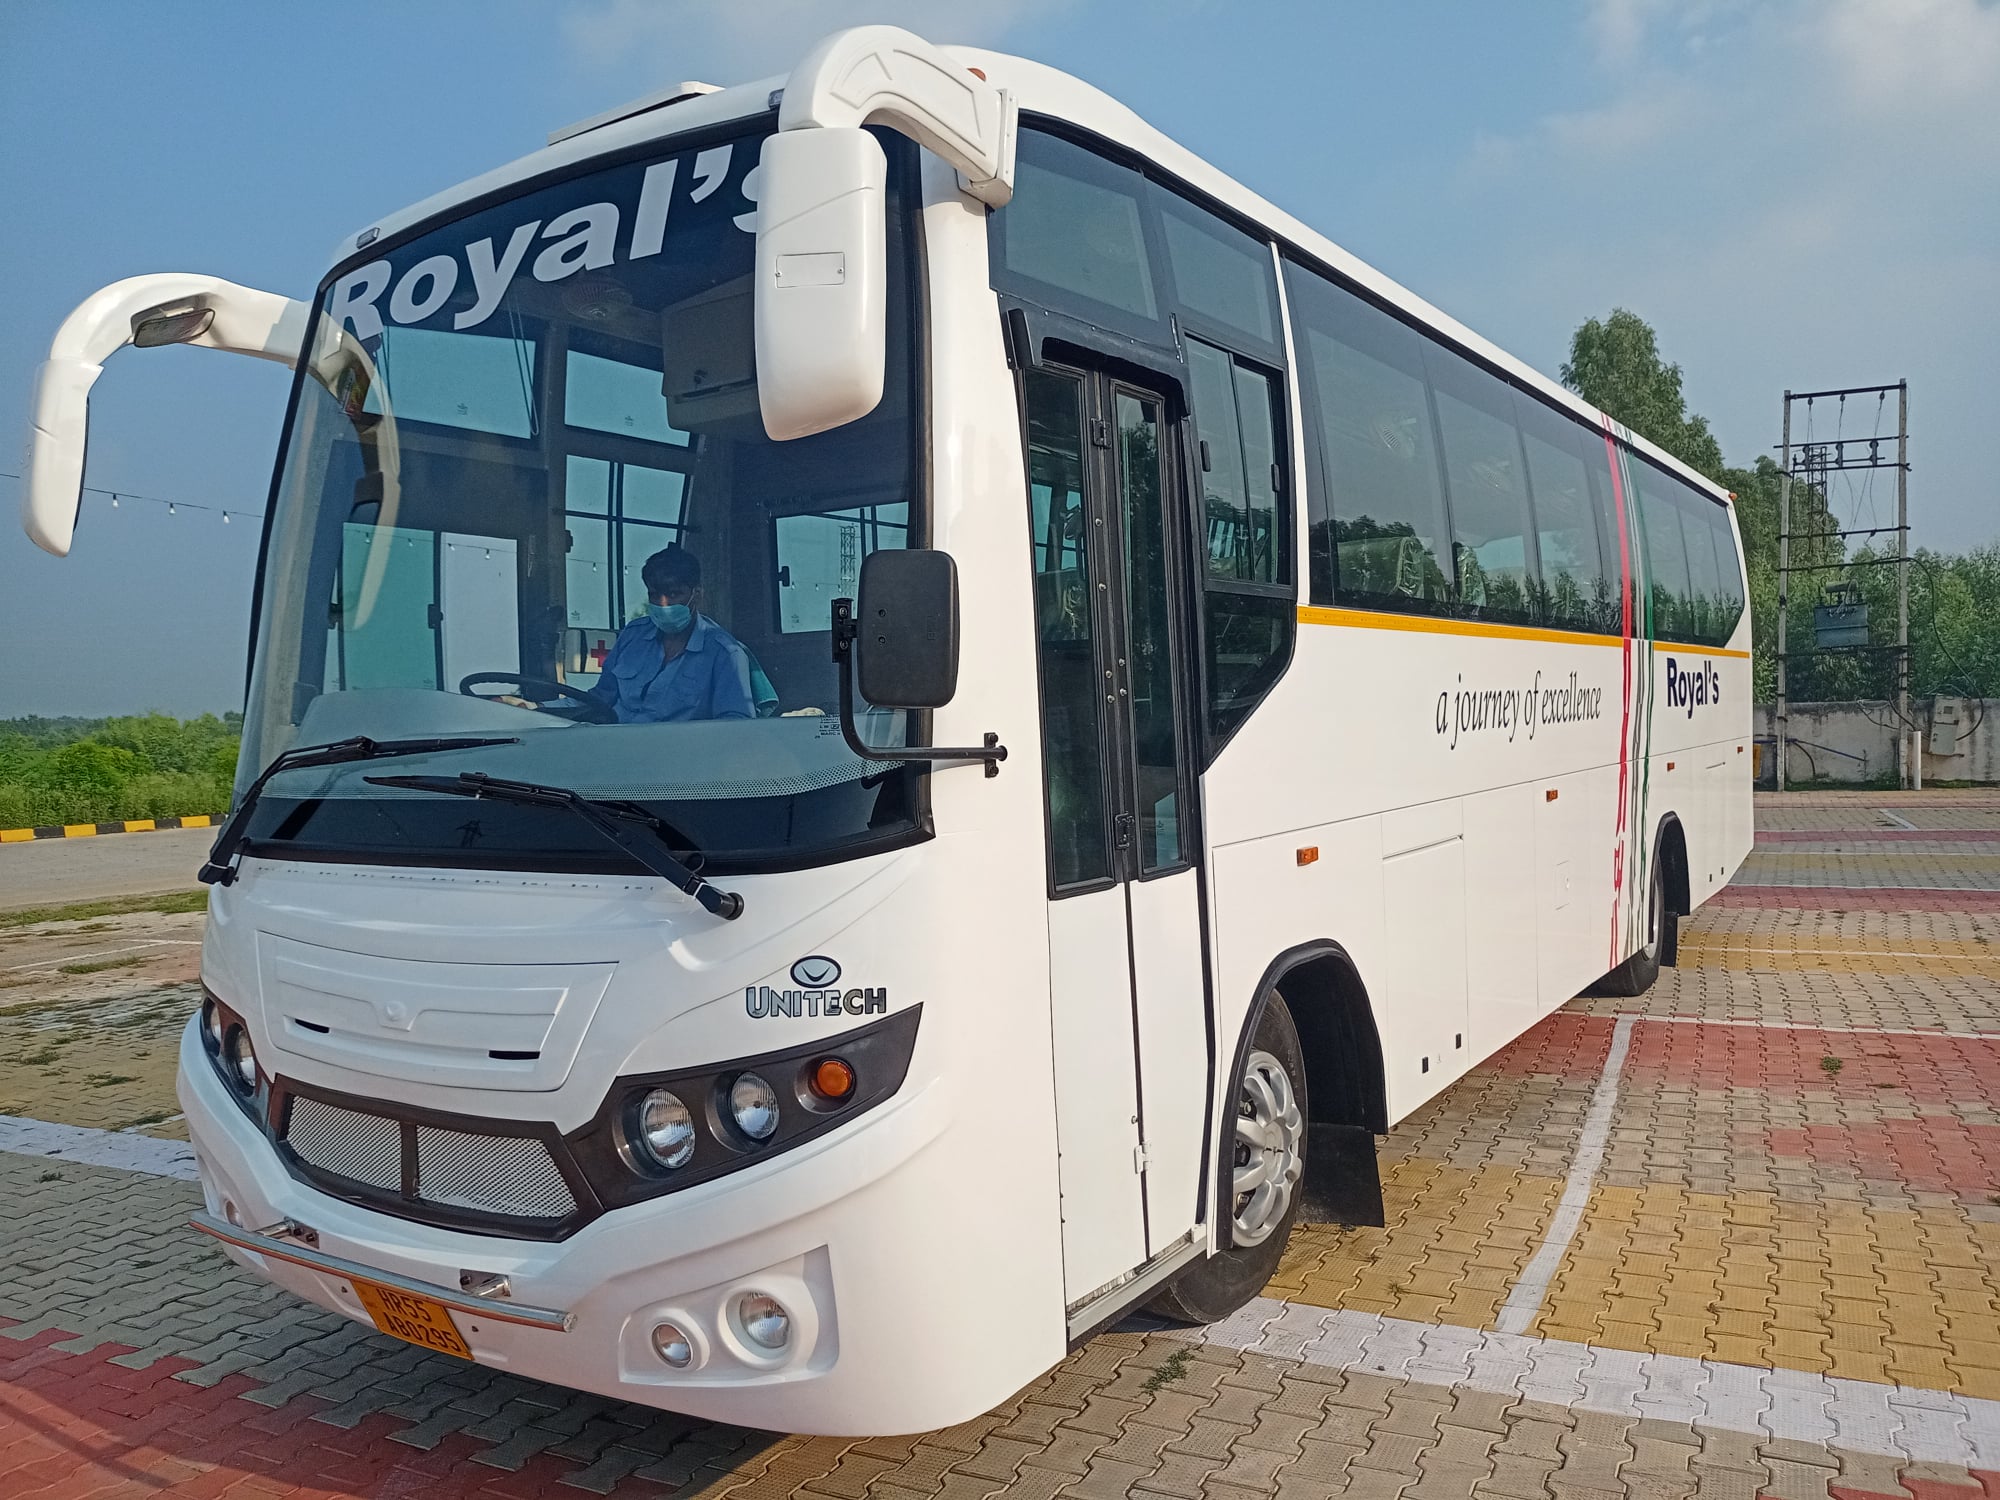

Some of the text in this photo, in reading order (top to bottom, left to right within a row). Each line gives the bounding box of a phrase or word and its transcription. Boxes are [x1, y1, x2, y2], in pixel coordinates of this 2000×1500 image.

[1667, 657, 1720, 719] Royal's
[1436, 670, 1602, 750] a journey of excellence
[745, 986, 887, 1019] UNITECH
[376, 1288, 432, 1322] HR55
[383, 1311, 462, 1352] AB0295
